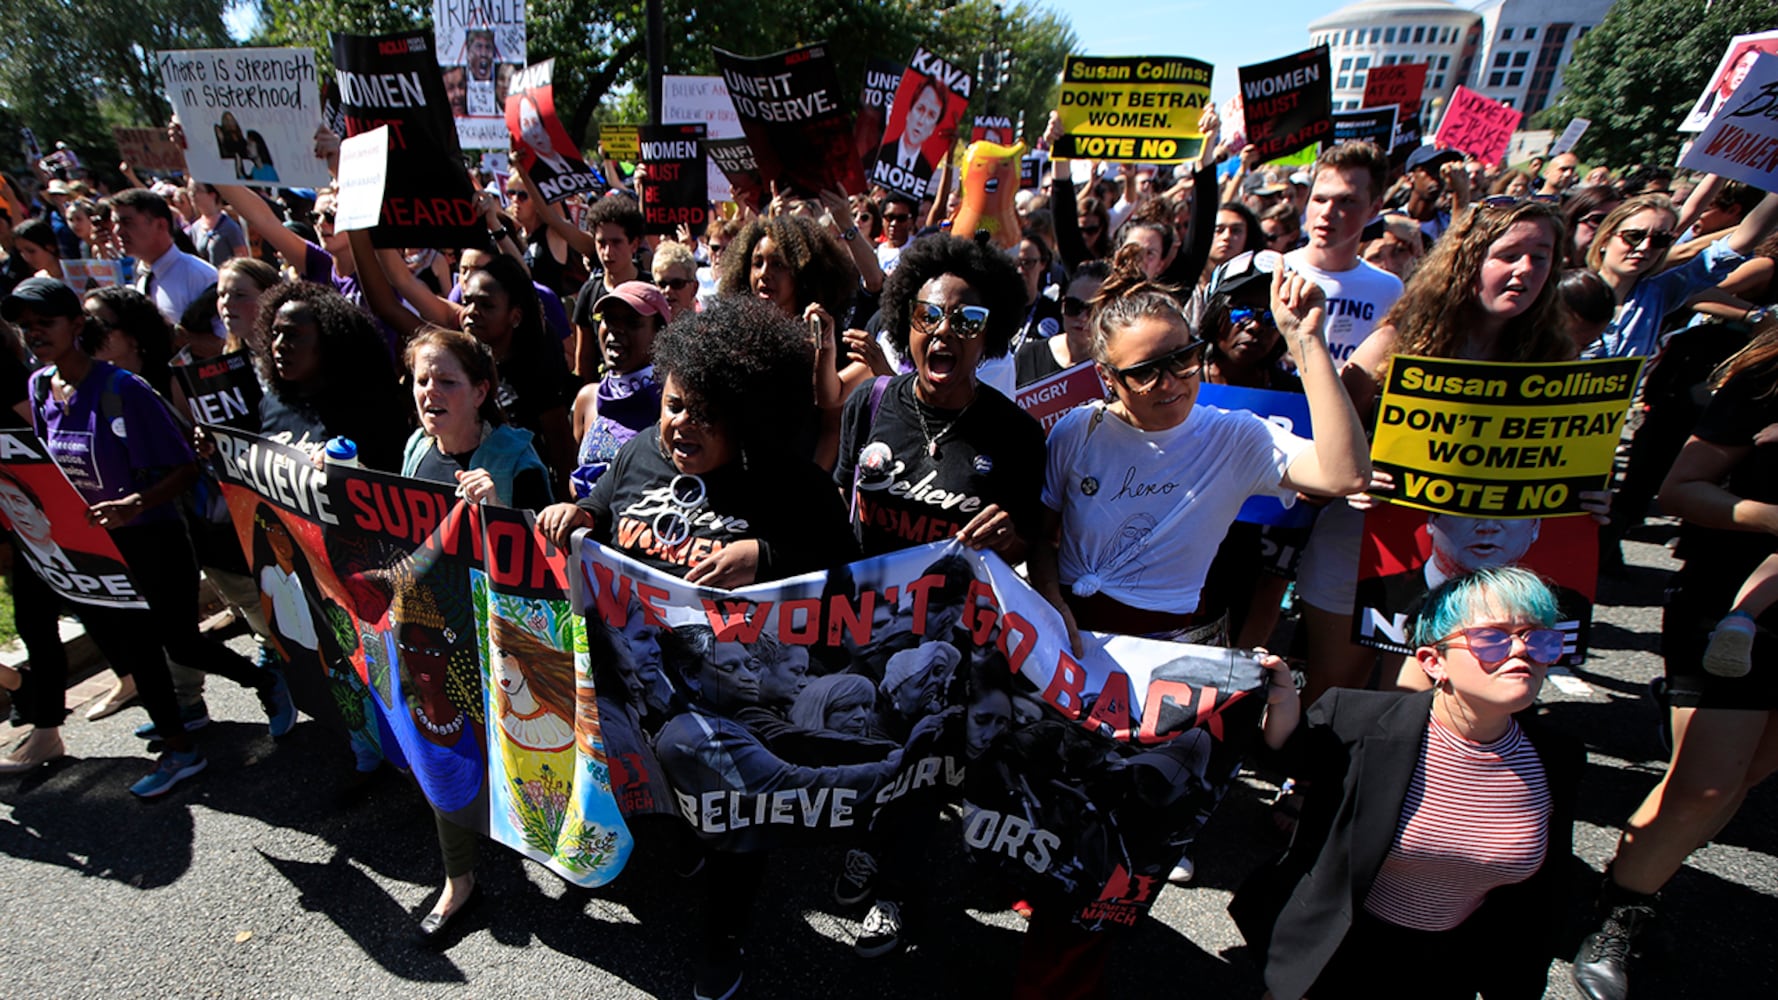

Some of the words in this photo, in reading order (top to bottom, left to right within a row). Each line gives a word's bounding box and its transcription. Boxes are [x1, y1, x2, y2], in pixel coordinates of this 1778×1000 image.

[724, 68, 792, 98] UNFIT
[911, 48, 973, 98] KAVA
[1072, 61, 1130, 79] Susan
[1136, 61, 1209, 82] Collins:
[1244, 63, 1320, 99] WOMEN
[182, 84, 198, 107] in
[335, 68, 427, 108] WOMEN
[864, 88, 882, 107] TO
[1061, 90, 1123, 107] DON'T
[1128, 91, 1209, 109] BETRAY
[732, 93, 757, 118] TO
[758, 89, 837, 122] SERVE.
[1088, 111, 1172, 128] WOMEN.
[640, 141, 697, 161] WOMEN
[1074, 137, 1135, 157] VOTE
[1140, 139, 1178, 159] NO
[538, 173, 602, 200] NOPE
[874, 159, 928, 198] NOPE
[645, 207, 705, 225] HEARD
[1016, 379, 1069, 411] ANGRY
[1400, 367, 1508, 397] Susan
[1519, 372, 1628, 399] Collins:
[1382, 404, 1492, 438] DON'T
[1500, 410, 1624, 440] BETRAY
[1427, 440, 1568, 470] WOMEN.
[211, 431, 341, 527] BELIEVE
[1110, 465, 1180, 501] hero
[1404, 472, 1509, 510] VOTE
[1517, 483, 1569, 511] NO
[581, 560, 674, 634] WE
[701, 573, 947, 644] WON'T
[962, 578, 1038, 676] GO
[1041, 649, 1253, 745] BACK
[673, 786, 859, 833] BELIEVE
